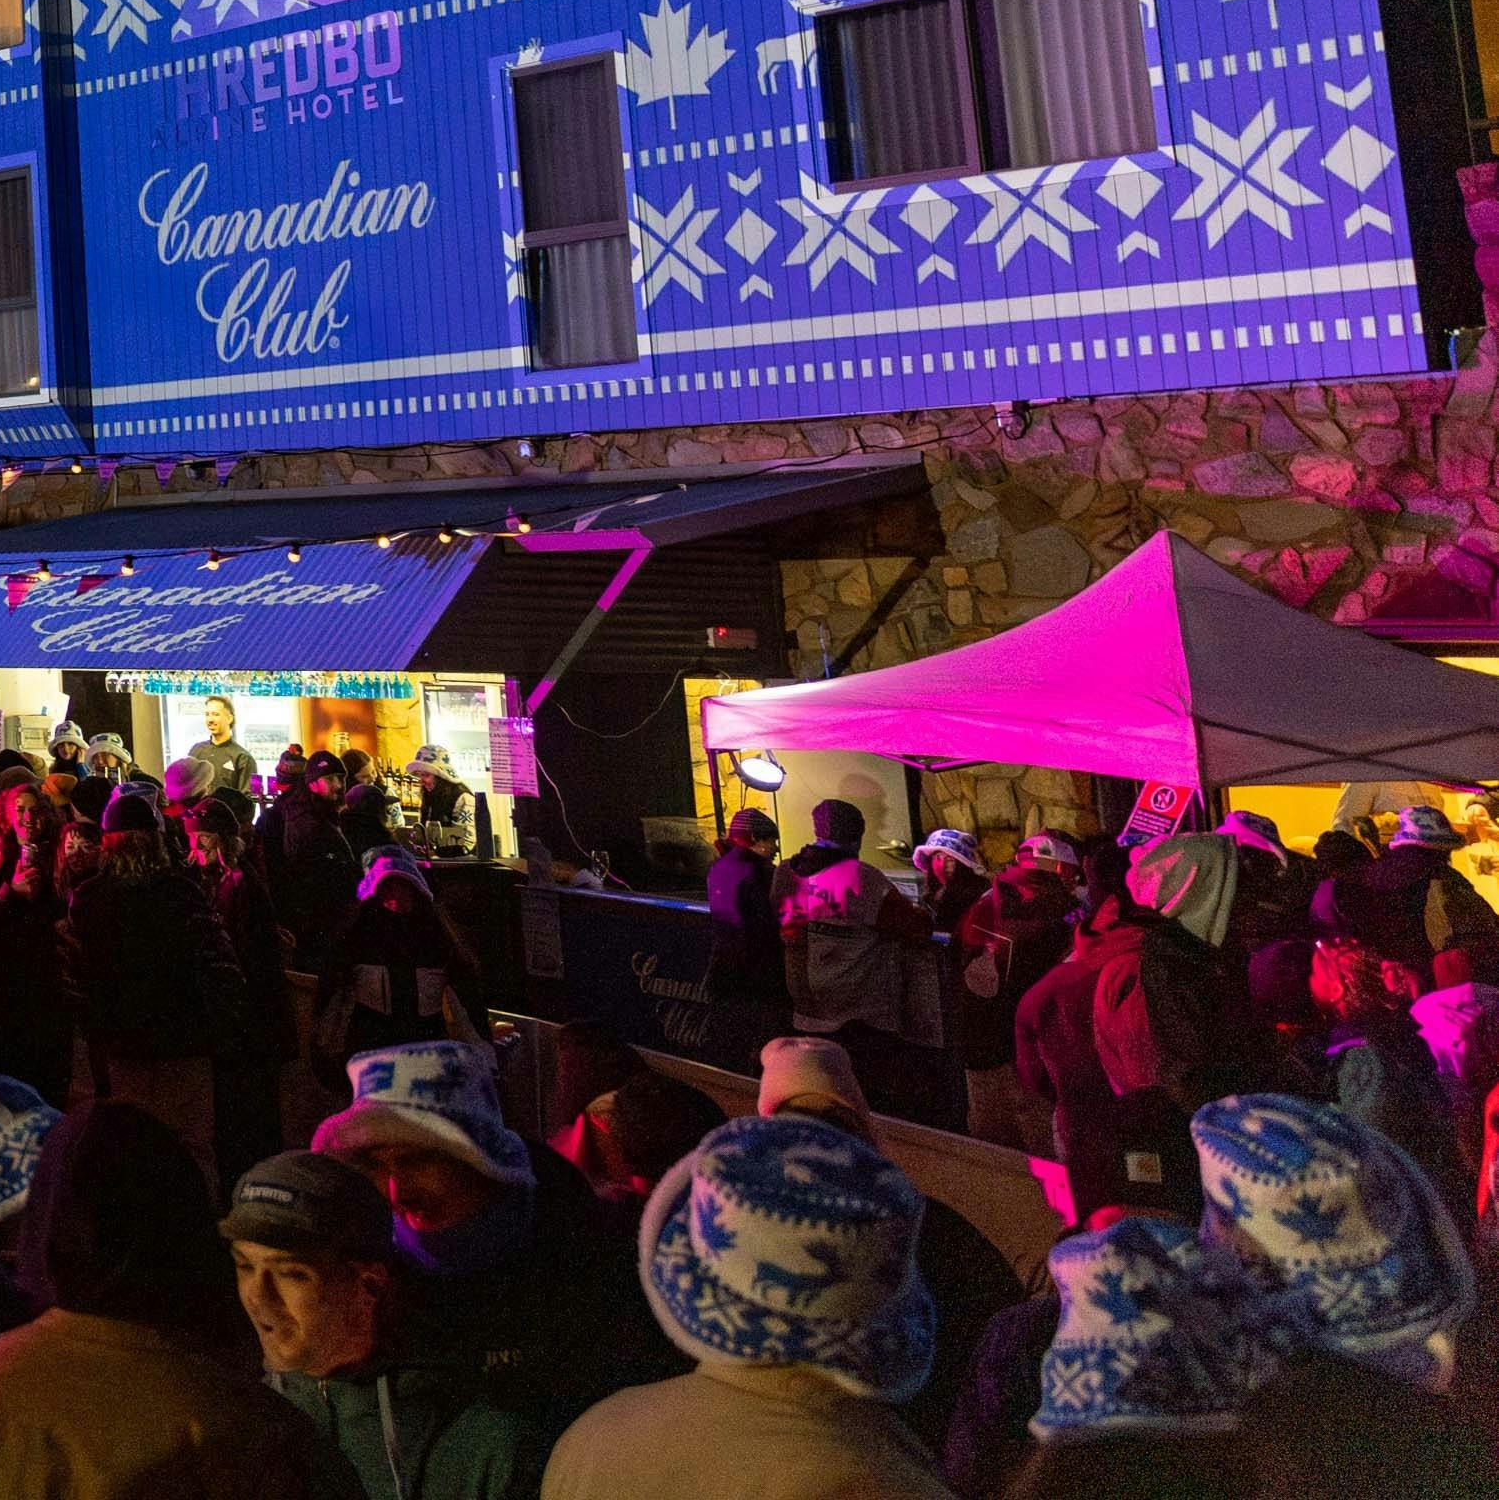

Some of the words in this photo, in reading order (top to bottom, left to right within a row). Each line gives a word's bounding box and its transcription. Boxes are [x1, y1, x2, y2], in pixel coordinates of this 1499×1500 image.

[287, 79, 404, 125] HOTEL
[138, 158, 435, 266] Canadian
[32, 608, 245, 653] Club
